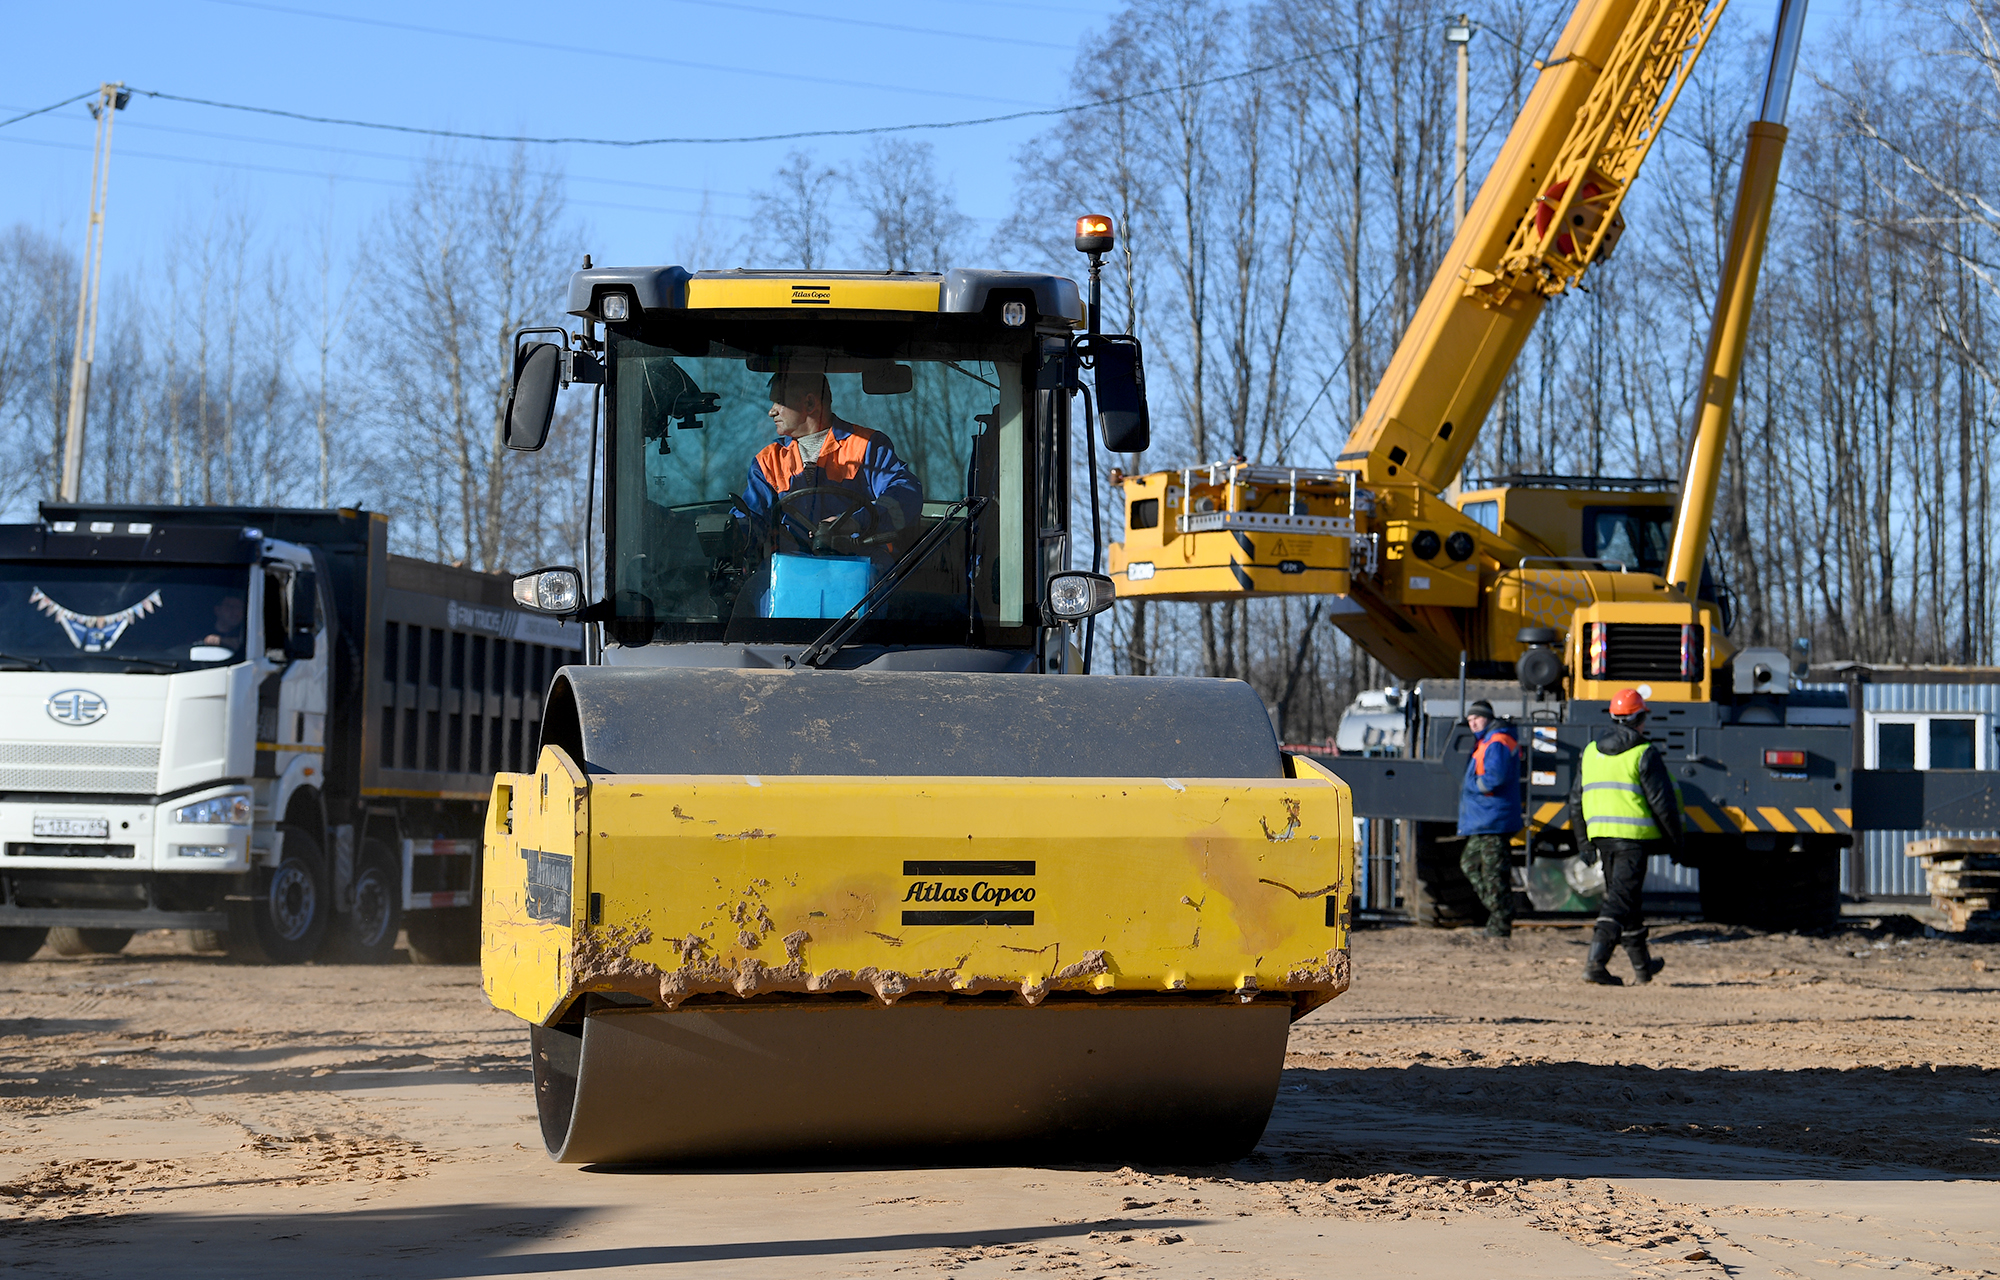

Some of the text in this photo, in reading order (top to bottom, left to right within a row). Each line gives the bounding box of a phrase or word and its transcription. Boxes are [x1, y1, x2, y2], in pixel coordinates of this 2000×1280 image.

[811, 291, 830, 299] Copco
[901, 881, 1036, 907] Atlas Copco
